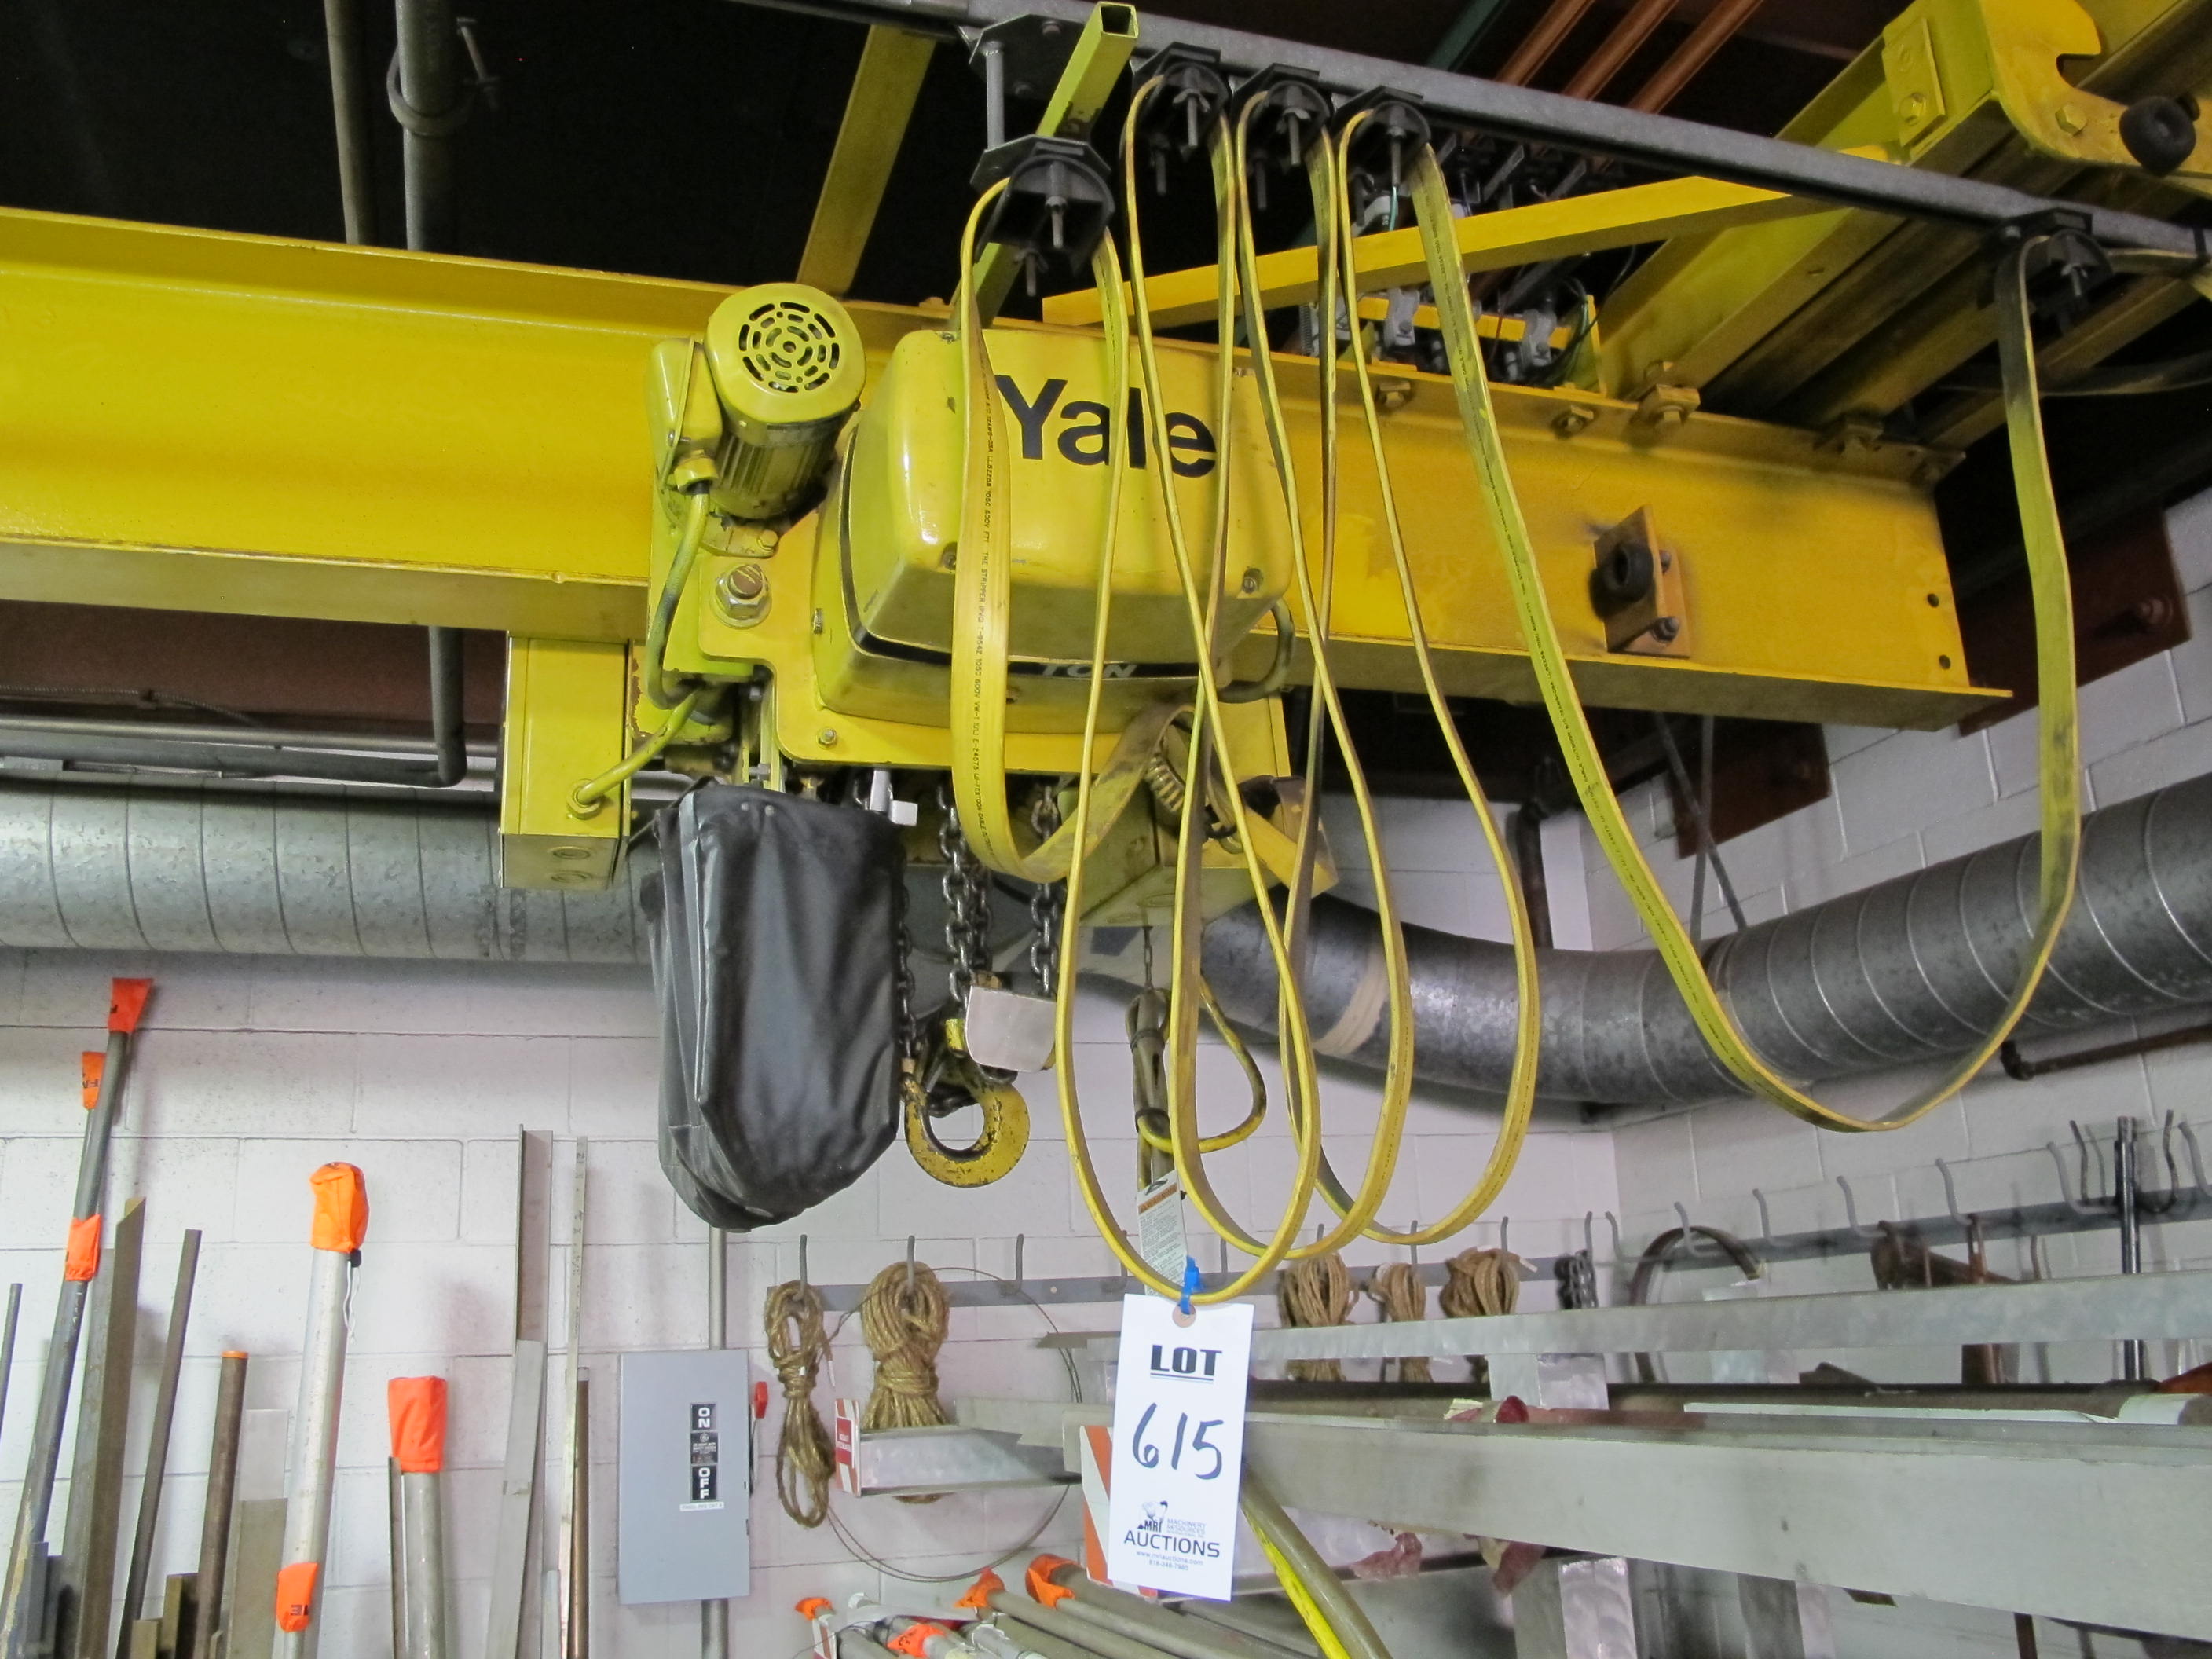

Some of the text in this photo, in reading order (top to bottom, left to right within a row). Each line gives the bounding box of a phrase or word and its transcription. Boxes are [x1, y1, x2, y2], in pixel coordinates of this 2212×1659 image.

[994, 374, 1216, 478] Yale
[979, 569, 987, 602] STRIPPER
[1040, 664, 1137, 678] TON
[1151, 1344, 1222, 1376] LOT
[698, 1407, 710, 1428] ON
[1132, 1402, 1225, 1480] 615
[698, 1467, 710, 1499] OFF
[1144, 1519, 1163, 1533] MRI
[1124, 1530, 1220, 1558] AUCTIONS
